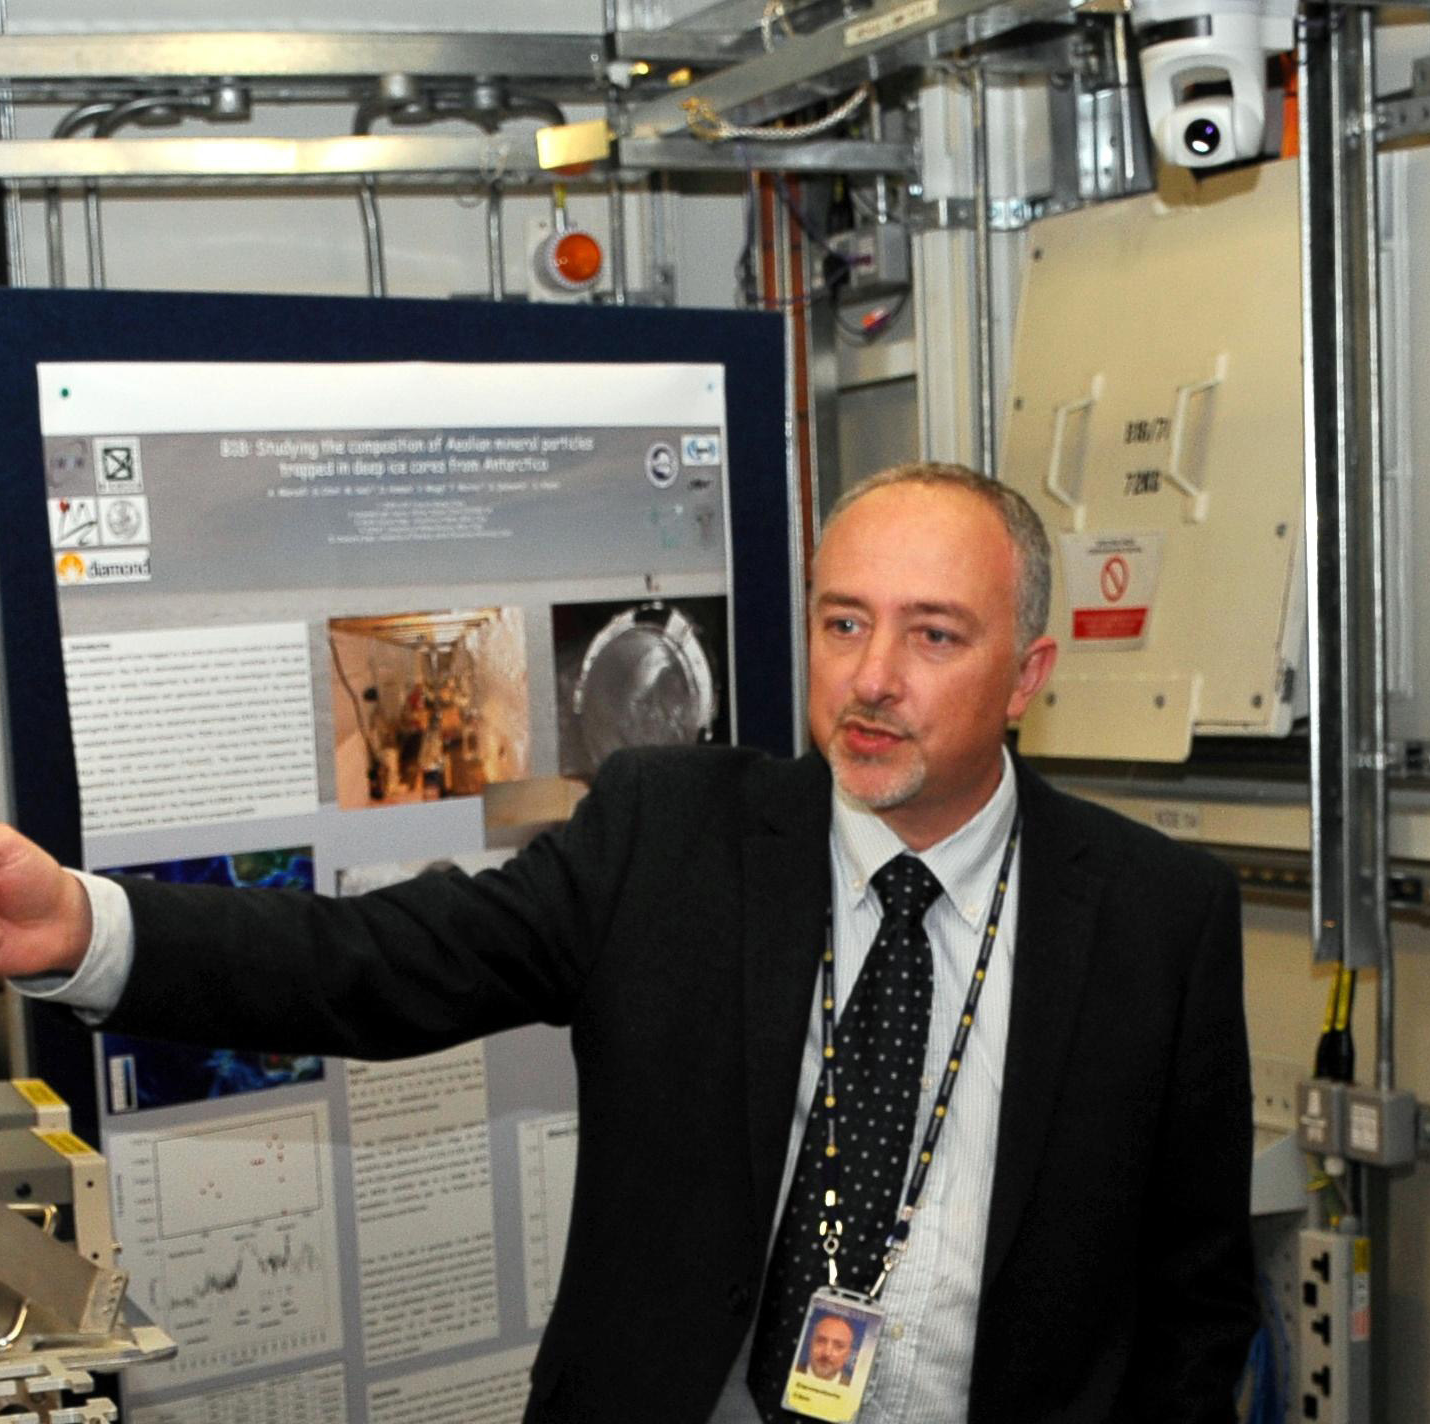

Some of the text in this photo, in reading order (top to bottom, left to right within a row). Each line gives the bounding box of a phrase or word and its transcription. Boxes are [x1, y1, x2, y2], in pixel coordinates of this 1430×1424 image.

[256, 438, 318, 460] Studying
[321, 437, 346, 455] the
[348, 437, 424, 458] composition
[427, 434, 443, 452] of
[541, 434, 595, 455] particles
[278, 460, 335, 481] trapped
[336, 461, 350, 476] in
[351, 458, 386, 479] deep
[409, 459, 447, 475] cores
[448, 456, 479, 473] from
[482, 456, 550, 473] Antarctica
[89, 557, 151, 578] diamond
